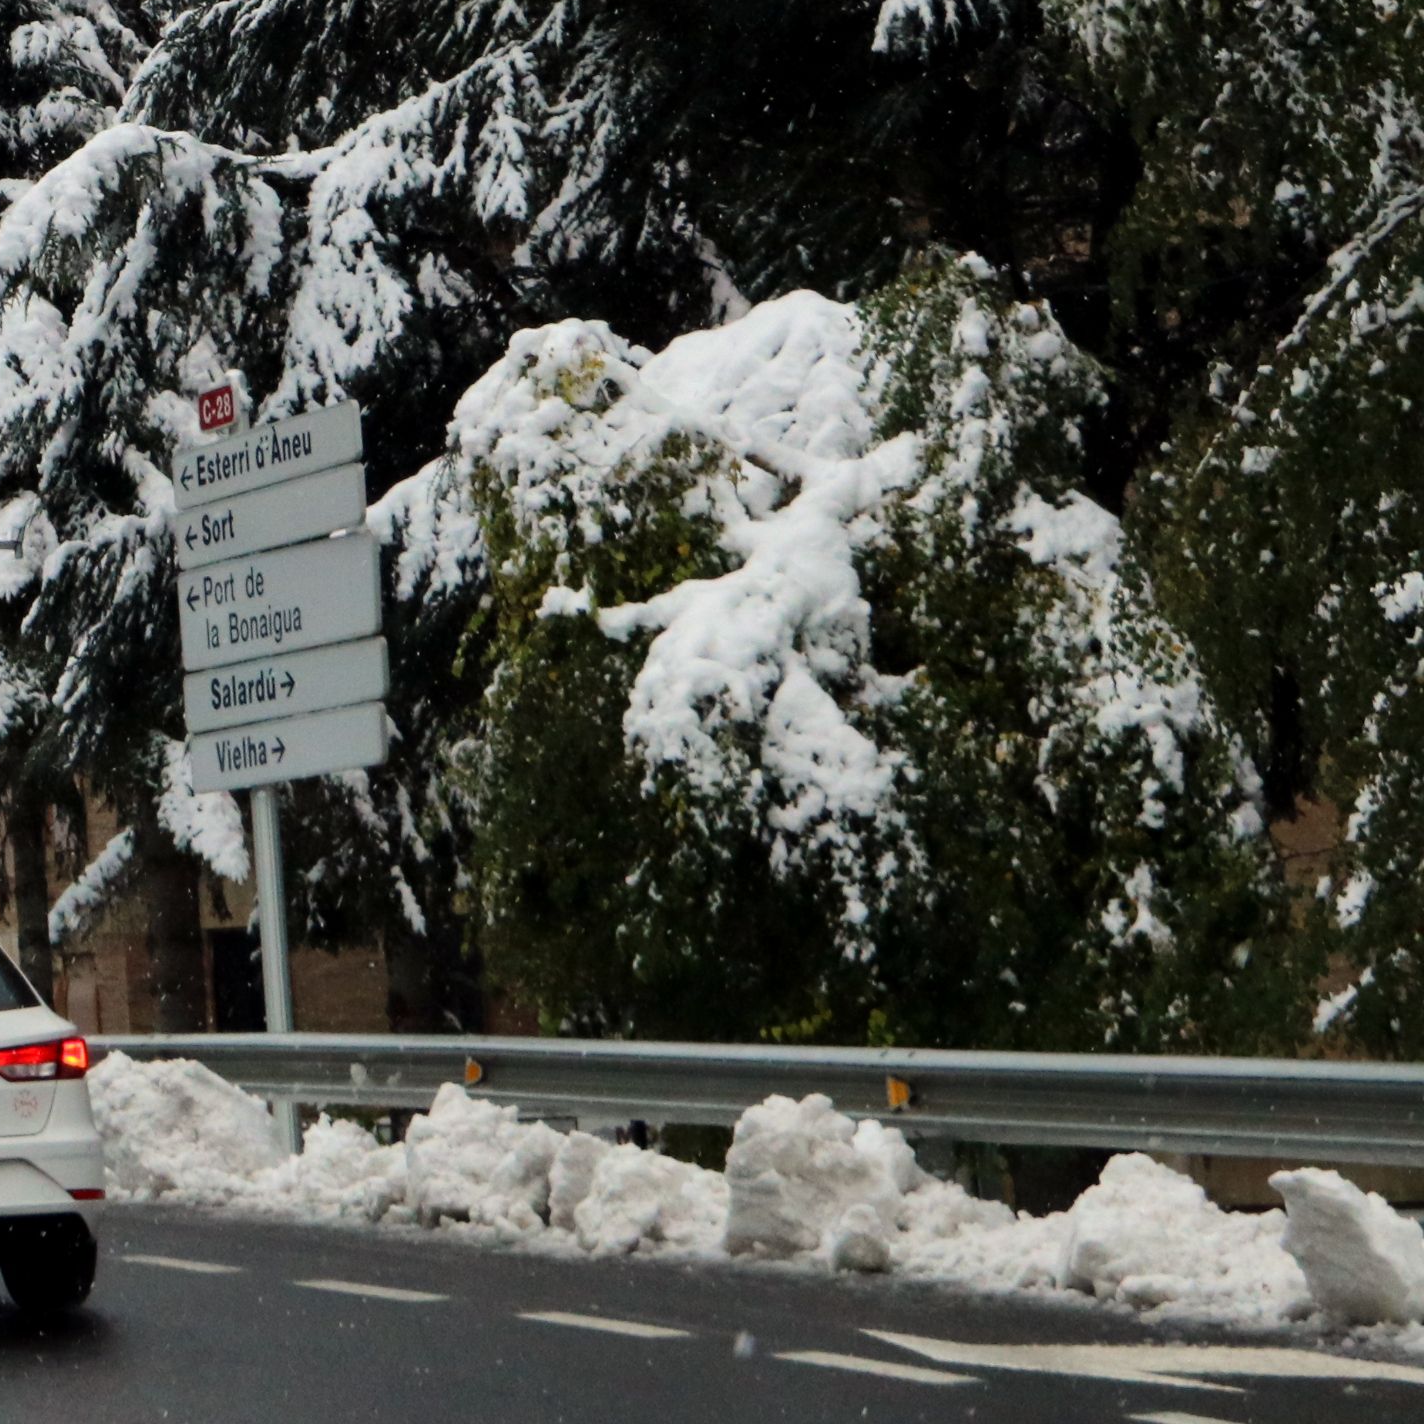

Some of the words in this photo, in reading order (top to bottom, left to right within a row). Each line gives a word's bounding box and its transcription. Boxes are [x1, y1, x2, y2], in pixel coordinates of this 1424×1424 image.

[202, 393, 232, 424] C-28
[196, 442, 250, 487] Esterri
[201, 509, 235, 546] Sort
[203, 572, 236, 607] Port
[245, 567, 265, 598] de
[205, 618, 220, 649] la
[228, 605, 303, 644] Bonaigua
[210, 668, 277, 710] Salardú
[215, 736, 268, 773] Vielha
